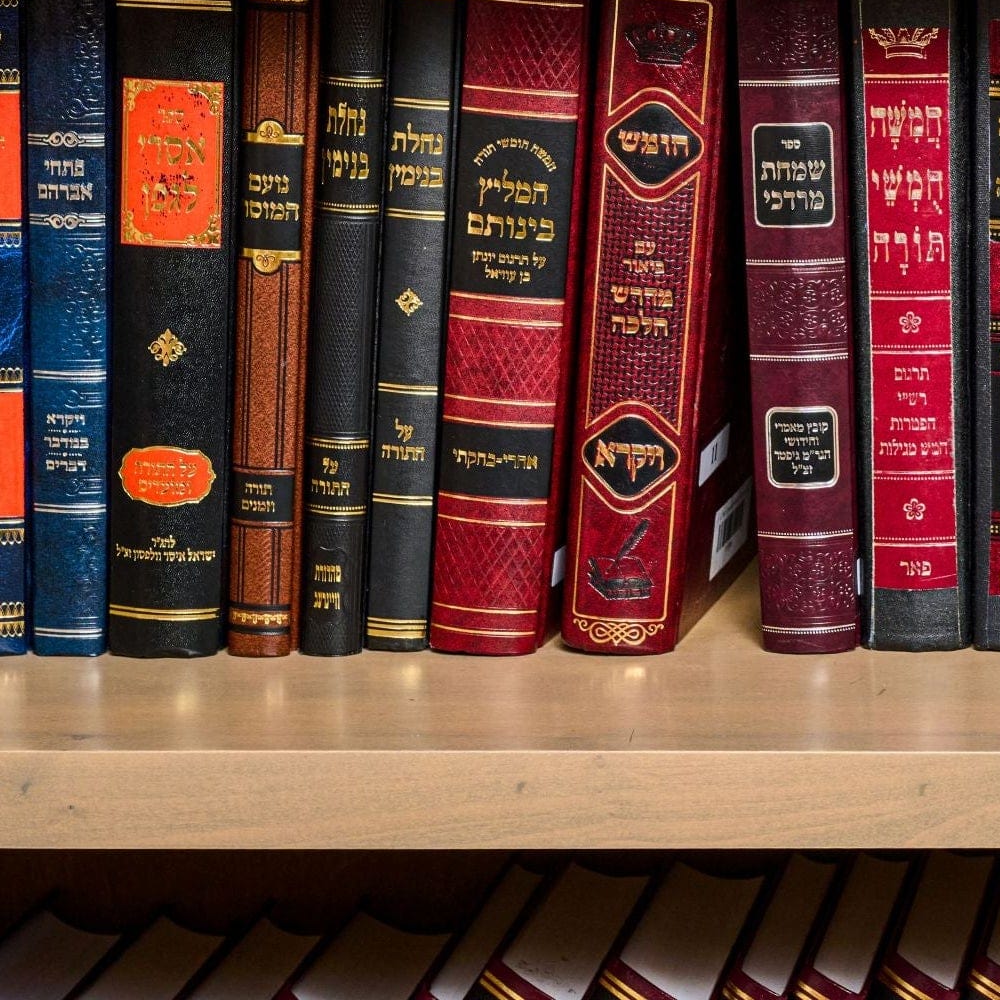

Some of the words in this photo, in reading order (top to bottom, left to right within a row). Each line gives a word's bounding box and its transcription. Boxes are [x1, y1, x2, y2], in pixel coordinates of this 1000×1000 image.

[326, 102, 366, 136] נחלת
[391, 122, 444, 155] נחלת
[618, 129, 689, 157] חומש
[781, 139, 801, 149] ספר
[138, 135, 205, 166] אסרי
[44, 159, 85, 177] פתחי
[322, 149, 369, 184] בנימין
[761, 159, 825, 181] שמחת
[249, 173, 289, 194] נועם
[389, 164, 444, 191] בנימין
[37, 182, 93, 201] אברהם
[142, 170, 198, 221] לגפן
[479, 168, 548, 207] המליץ
[764, 190, 824, 211] מרדכי
[467, 211, 555, 241] בינותם
[635, 240, 656, 255] עם
[472, 250, 496, 264] יונתן
[499, 253, 529, 265] תרגום
[532, 252, 547, 269] על
[622, 258, 664, 275] ביאור
[520, 271, 531, 284] בן
[611, 284, 673, 308] מדרש
[611, 309, 669, 337] הלכה
[894, 367, 929, 380] תרגום
[46, 413, 85, 426] ויקרא
[775, 423, 804, 432] מאמרי
[807, 422, 828, 434] קובץ
[890, 417, 935, 430] הפטרות
[394, 417, 414, 442] על
[44, 436, 89, 449] במדבר
[784, 436, 819, 446] וחידושי
[879, 439, 917, 455] מגילות
[921, 442, 947, 455] חמש
[382, 444, 426, 462] התורה
[595, 439, 664, 482] ויקרא
[46, 459, 87, 471] דברים
[322, 457, 339, 474] על
[311, 479, 350, 496] התורה
[164, 551, 185, 561] איסר
[188, 548, 215, 561] ישראל
[900, 561, 931, 577] פאר
